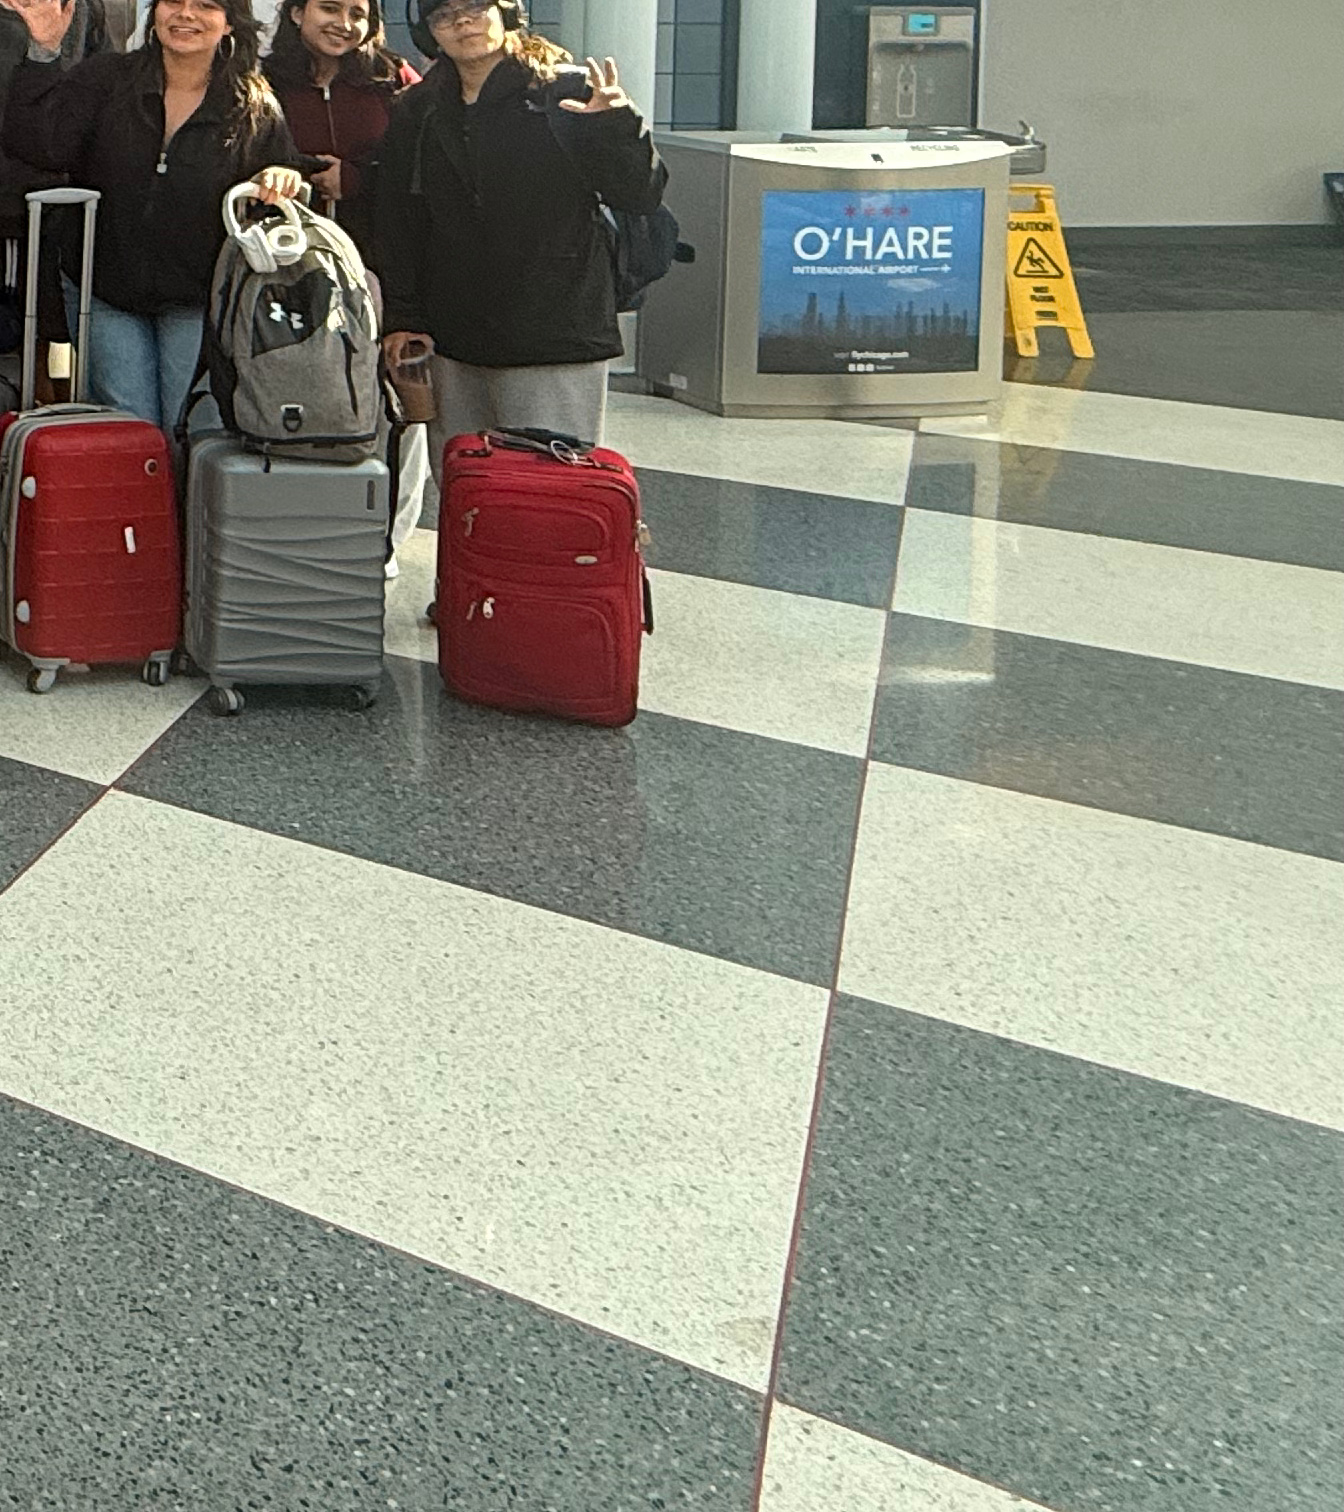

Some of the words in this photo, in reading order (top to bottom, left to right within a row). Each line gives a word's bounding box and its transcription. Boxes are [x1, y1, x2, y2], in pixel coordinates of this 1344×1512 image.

[1007, 220, 1054, 231] CAUTION
[793, 225, 954, 261] O'HARE
[792, 265, 874, 274] INTERNATIONAL
[878, 265, 919, 274] AIRPORT
